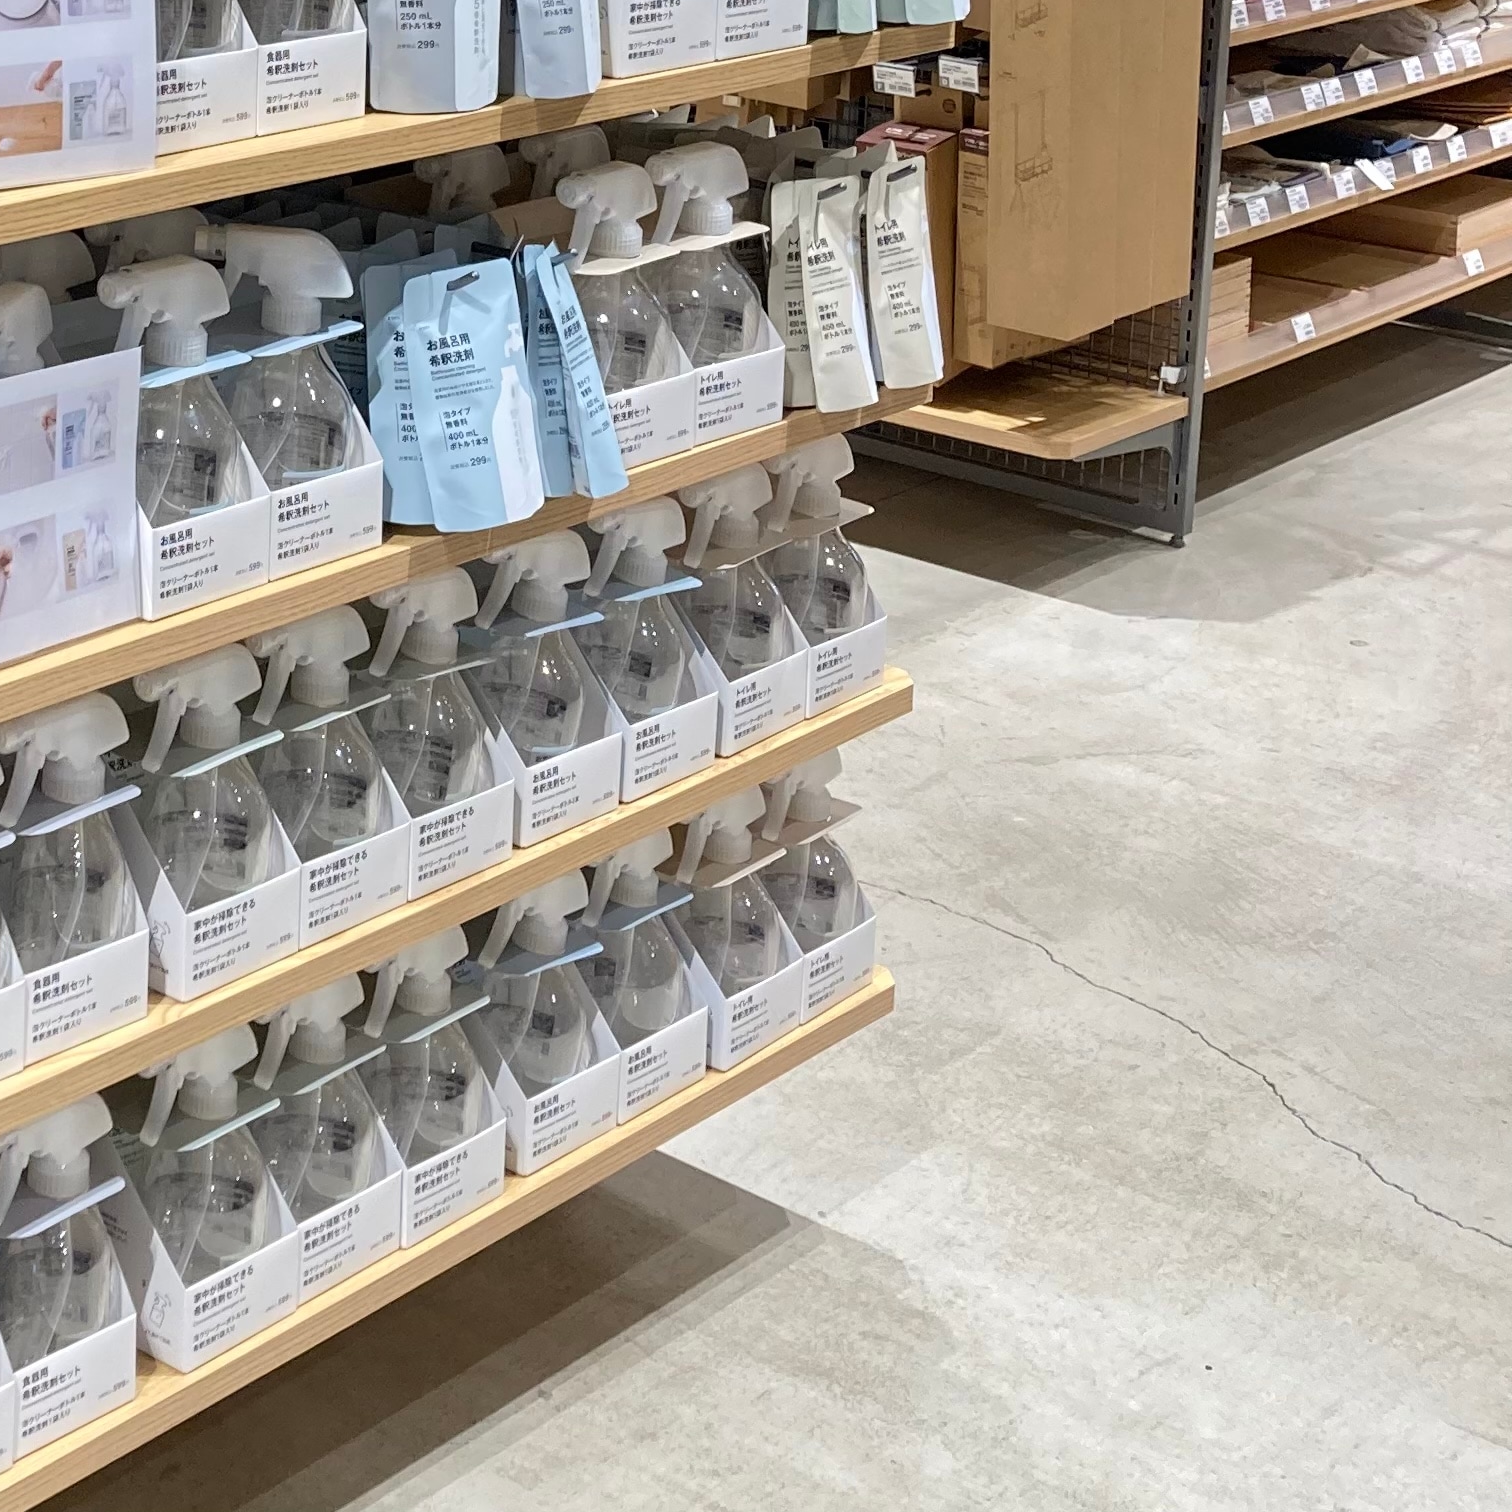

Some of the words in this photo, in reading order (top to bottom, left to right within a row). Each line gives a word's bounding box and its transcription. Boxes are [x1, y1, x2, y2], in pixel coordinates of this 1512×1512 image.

[419, 12, 432, 20] mL
[267, 49, 290, 62] 食器用
[266, 60, 318, 76] 希釈洗剤セット
[427, 333, 470, 351] お風呂用
[430, 348, 474, 367] 希釈洗剤
[700, 371, 723, 384] トイレ用
[449, 431, 464, 441] 400
[466, 429, 478, 437] mL
[278, 492, 309, 509] お風呂用
[278, 500, 329, 523] 希釈洗剤セット
[161, 528, 193, 546] お風呂用
[161, 536, 214, 560] 希釈洗剤セット
[33, 972, 60, 991] 食器用
